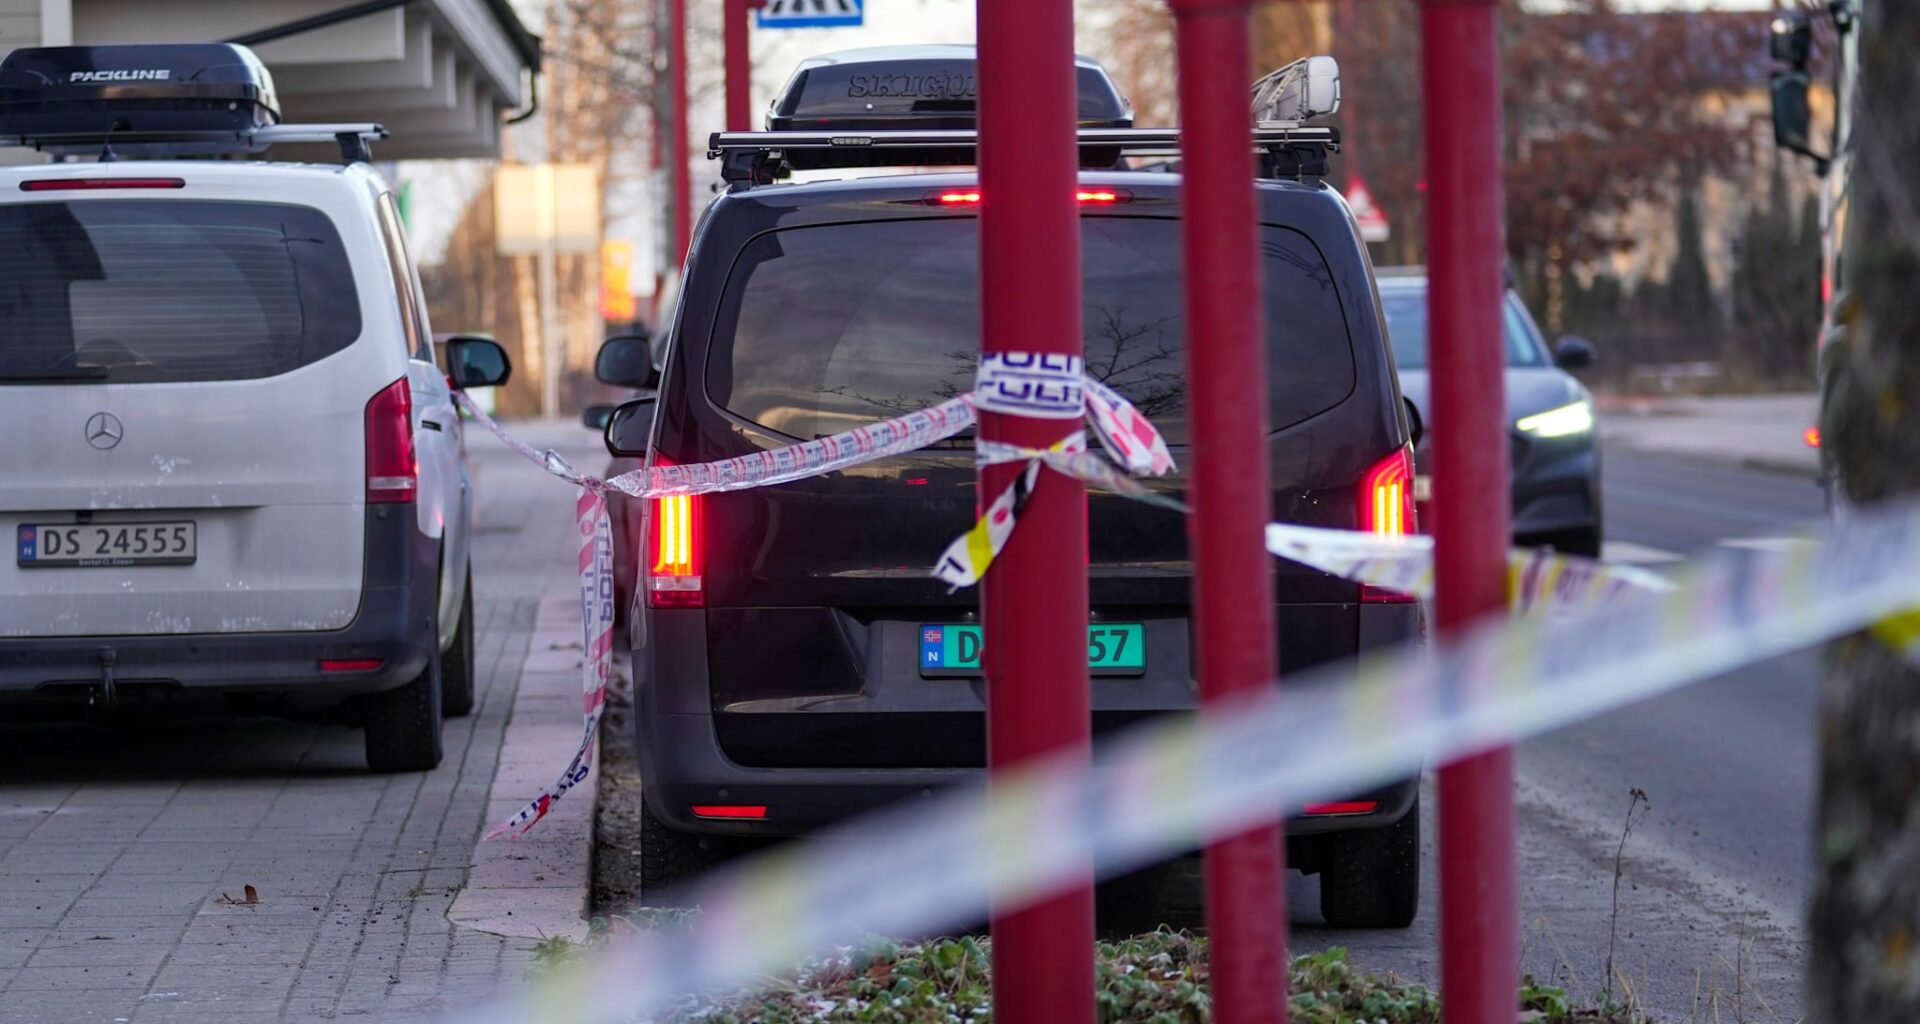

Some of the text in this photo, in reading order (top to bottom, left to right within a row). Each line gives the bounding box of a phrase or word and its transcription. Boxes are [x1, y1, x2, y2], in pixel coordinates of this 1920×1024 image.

[69, 69, 170, 82] PACKLINE
[848, 73, 978, 98] SKIGU
[44, 527, 187, 555] DS 24555
[23, 547, 32, 556] N
[928, 651, 938, 662] N
[958, 631, 981, 663] D
